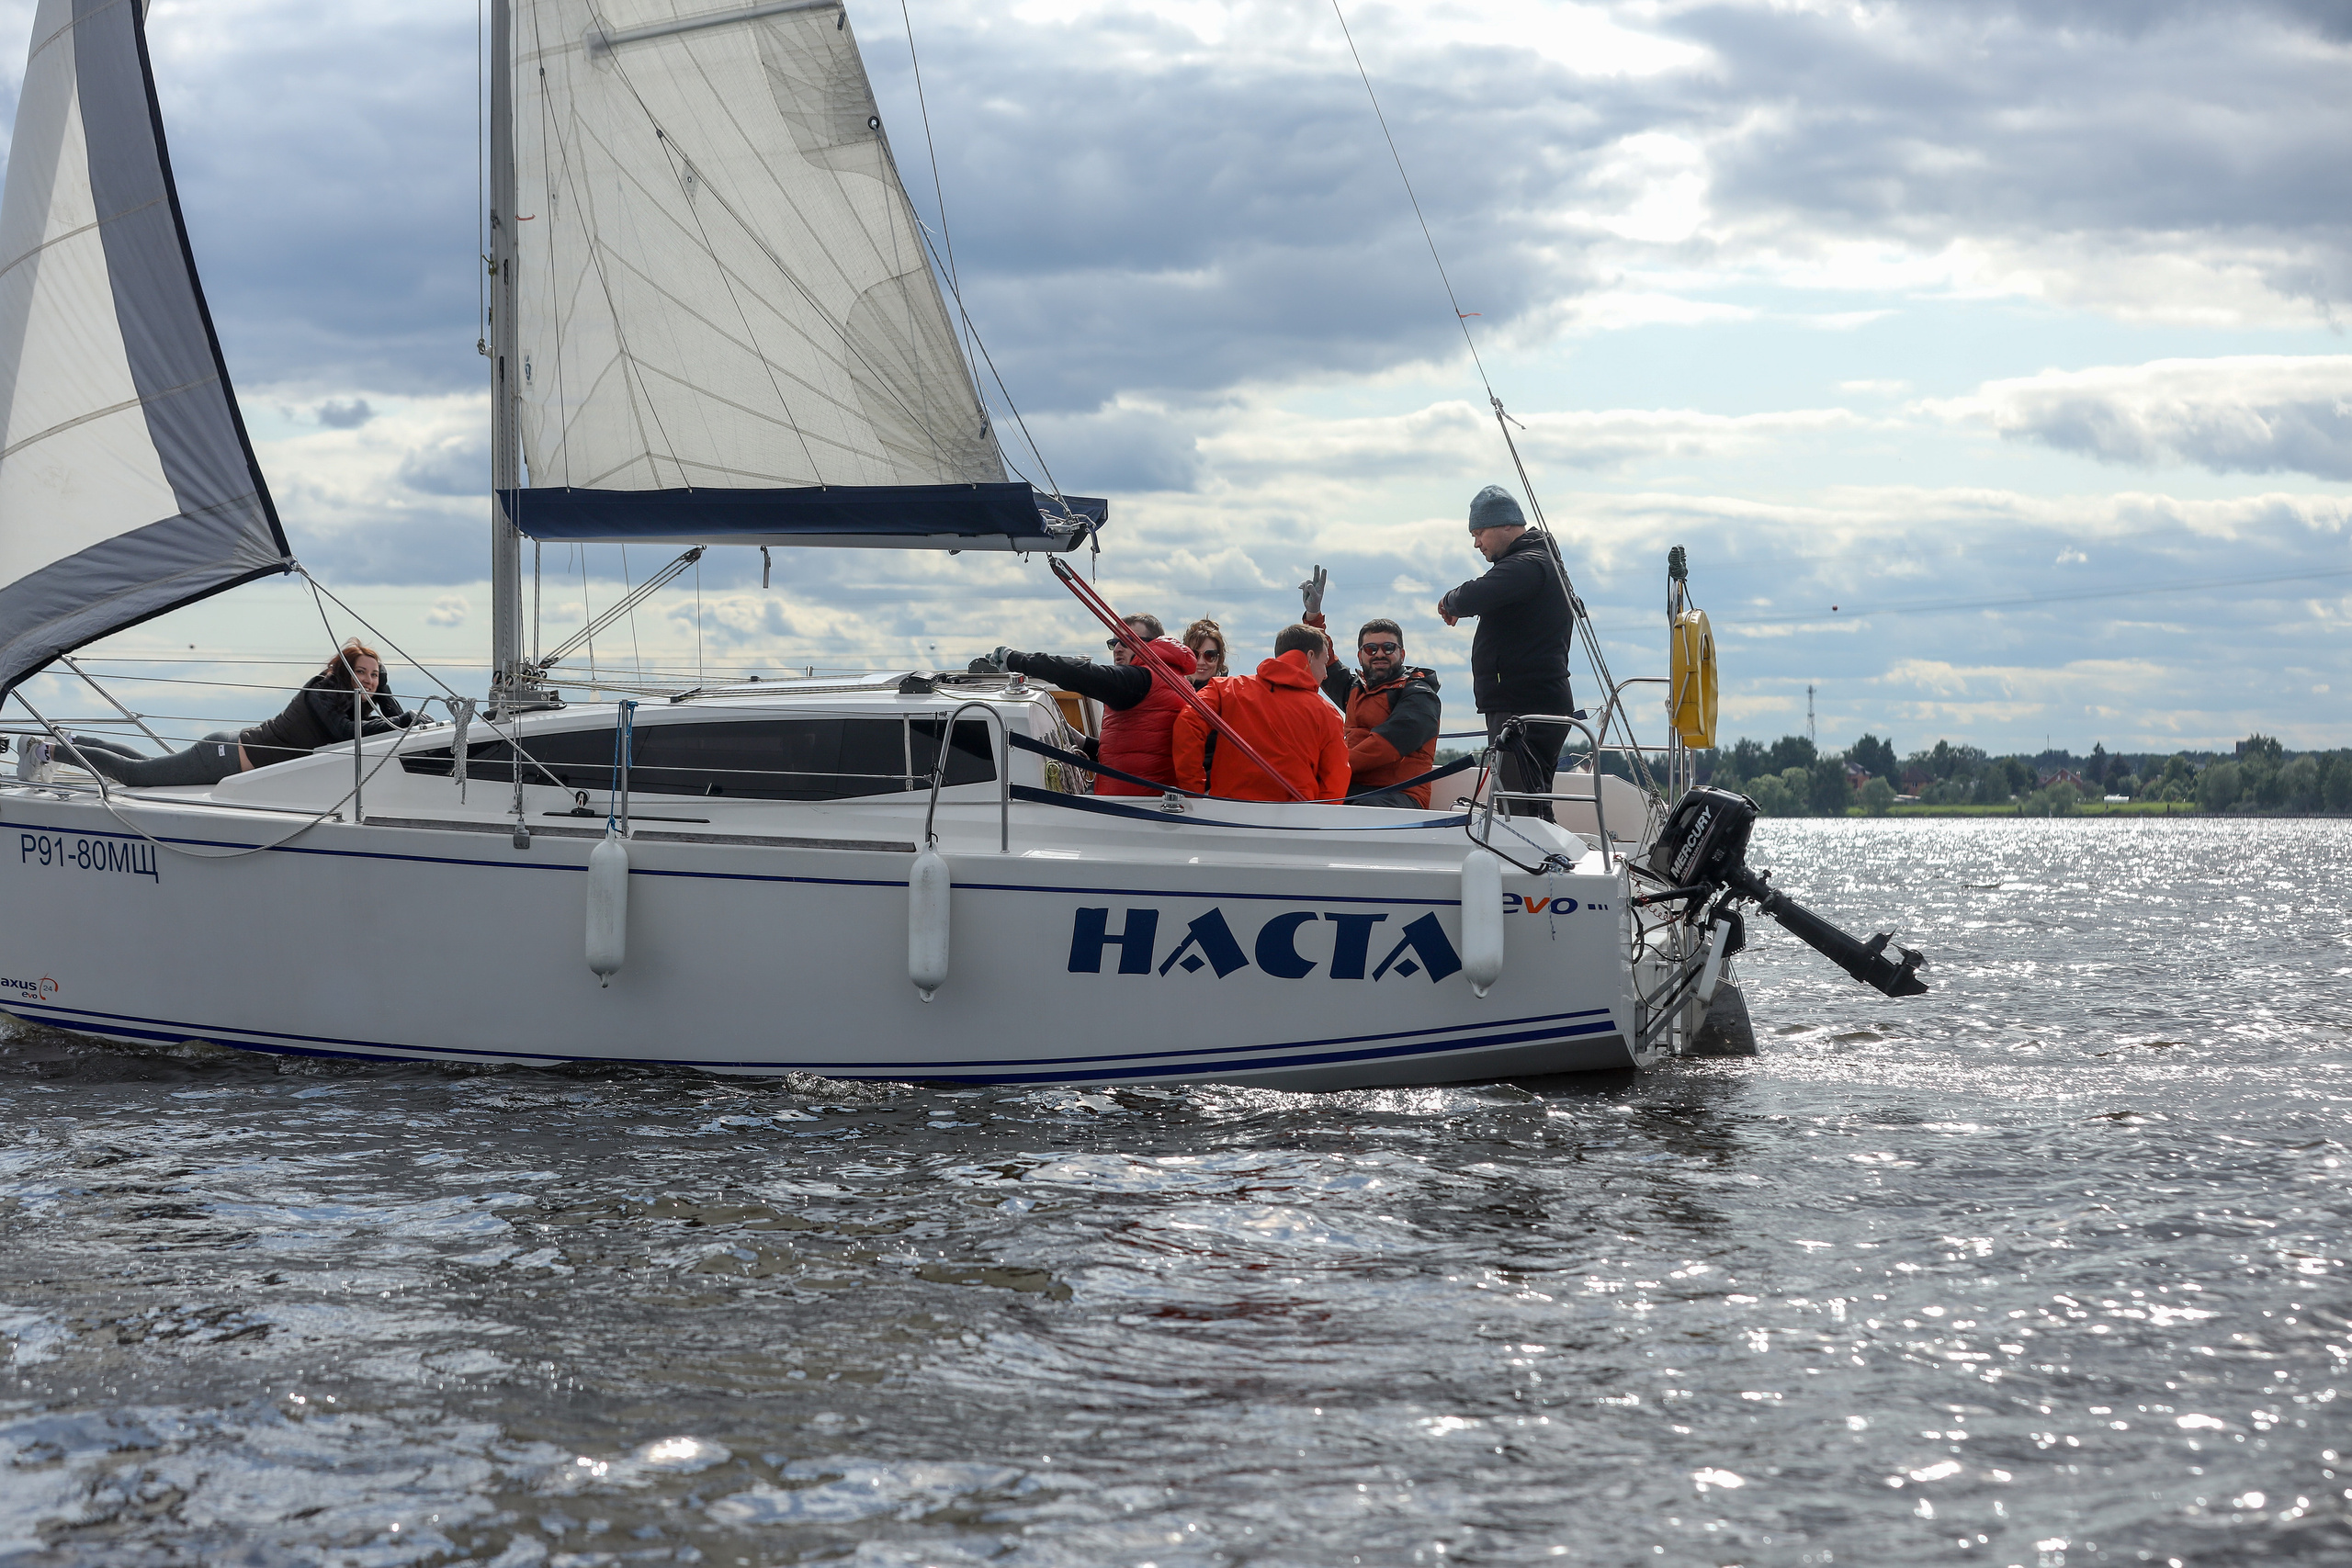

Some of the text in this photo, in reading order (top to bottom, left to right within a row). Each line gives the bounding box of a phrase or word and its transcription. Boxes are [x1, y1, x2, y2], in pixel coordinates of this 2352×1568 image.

[20, 833, 159, 884] Р91-80МЩ
[1670, 805, 1712, 879] MERCURY
[1502, 892, 1578, 915] evo
[1067, 906, 1463, 985] НАСТА
[0, 977, 37, 991] axus
[21, 991, 38, 999] evo
